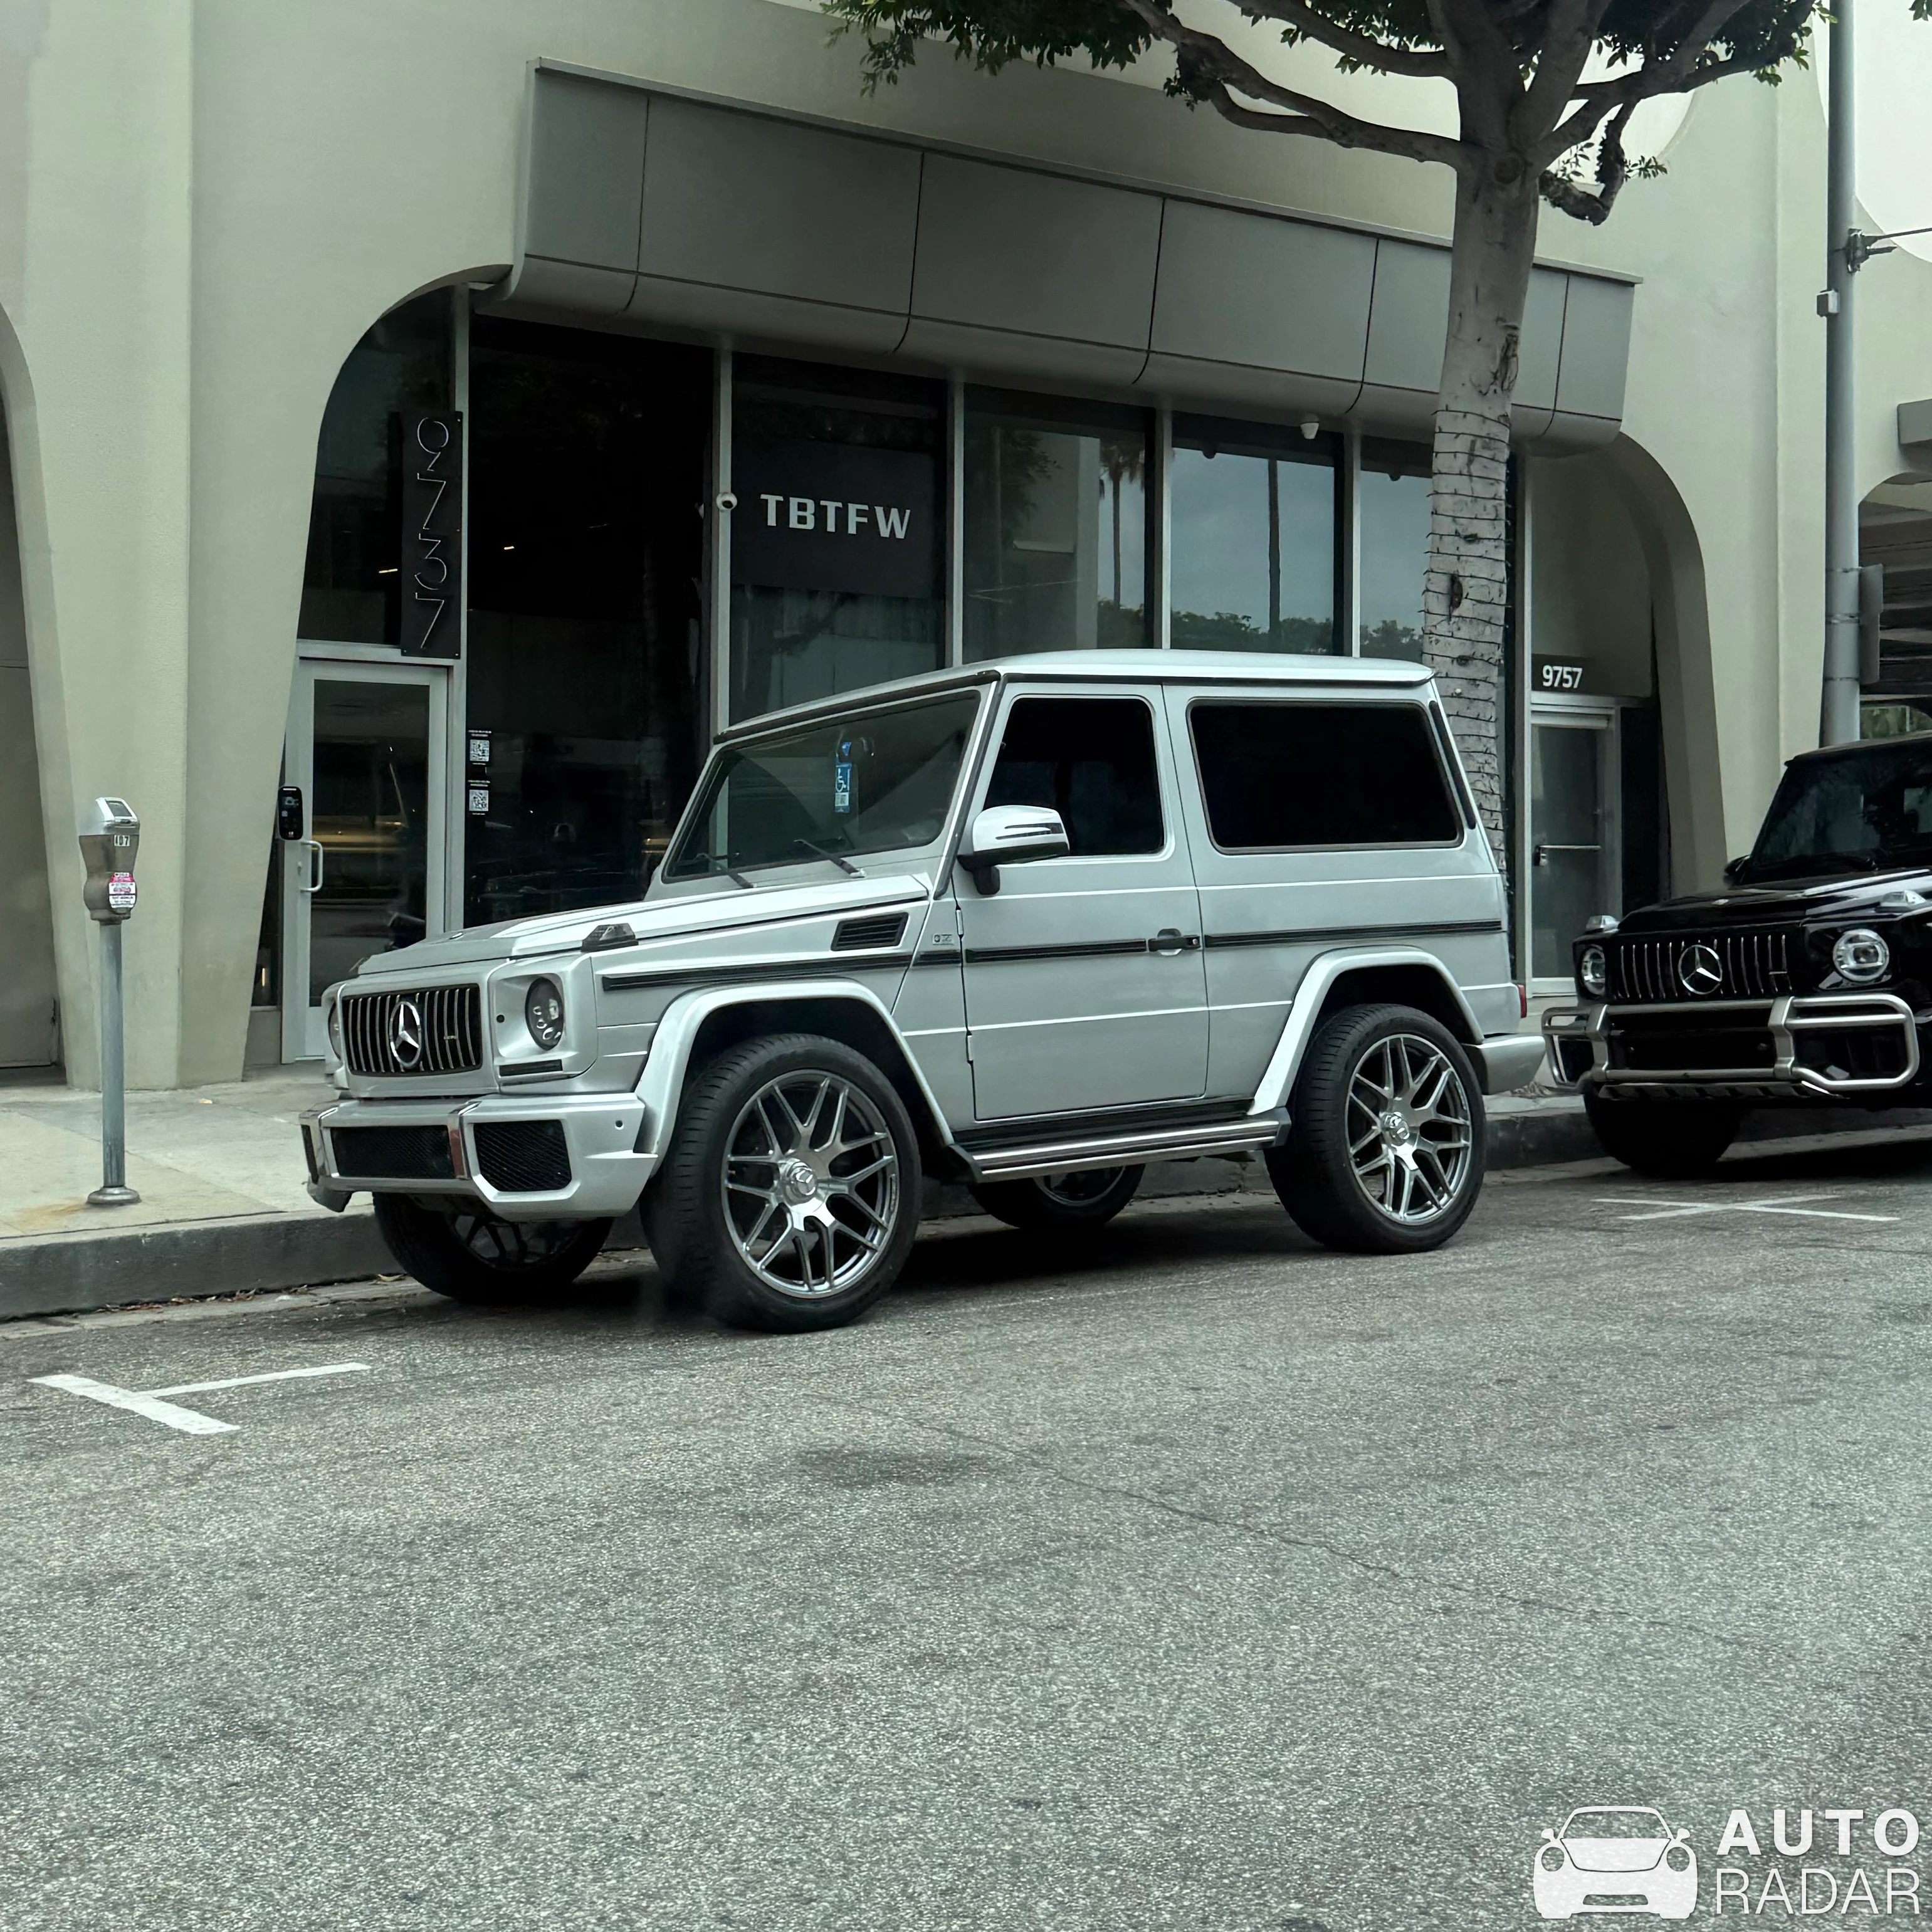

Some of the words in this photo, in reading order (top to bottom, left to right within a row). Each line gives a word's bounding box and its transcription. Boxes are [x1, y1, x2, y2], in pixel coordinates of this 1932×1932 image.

[414, 417, 449, 648] 9737
[760, 494, 911, 539] TBTFW
[1543, 664, 1583, 688] 9757
